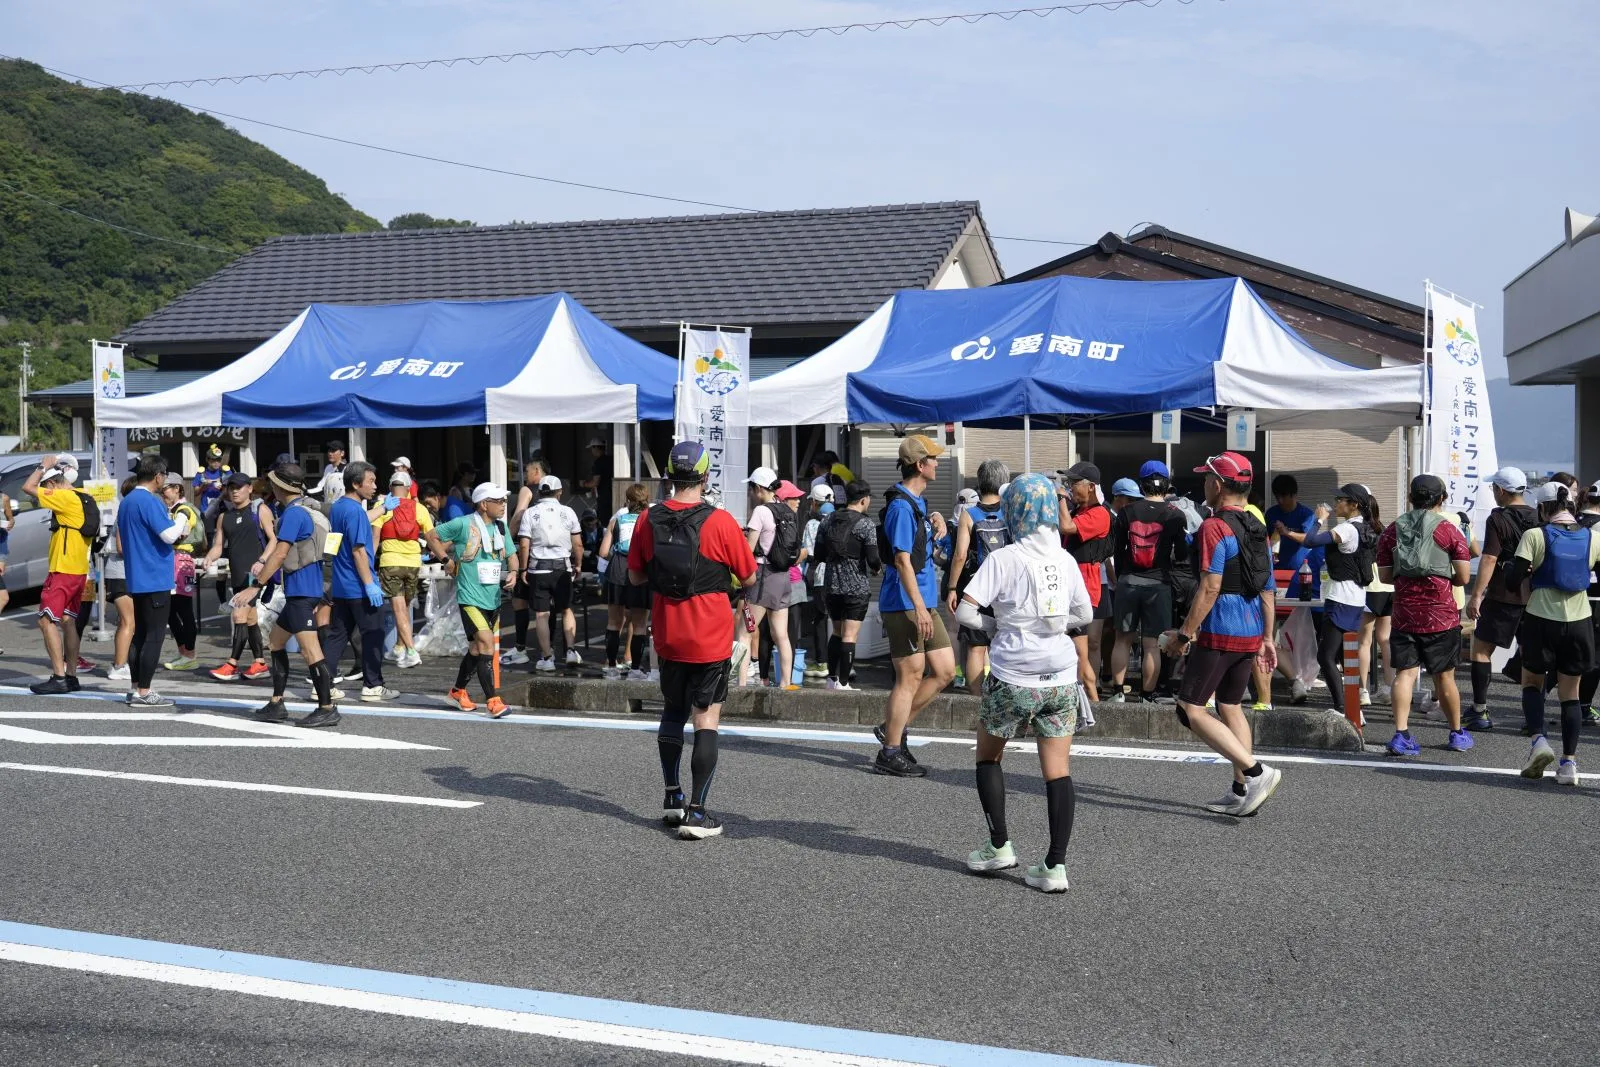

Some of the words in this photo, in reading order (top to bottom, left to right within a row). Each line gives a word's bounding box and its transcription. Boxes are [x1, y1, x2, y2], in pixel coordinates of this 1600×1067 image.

[1008, 332, 1125, 362] 愛南町
[370, 357, 464, 378] 愛南町
[1463, 377, 1478, 512] 愛南マラニック
[1044, 564, 1058, 591] 333
